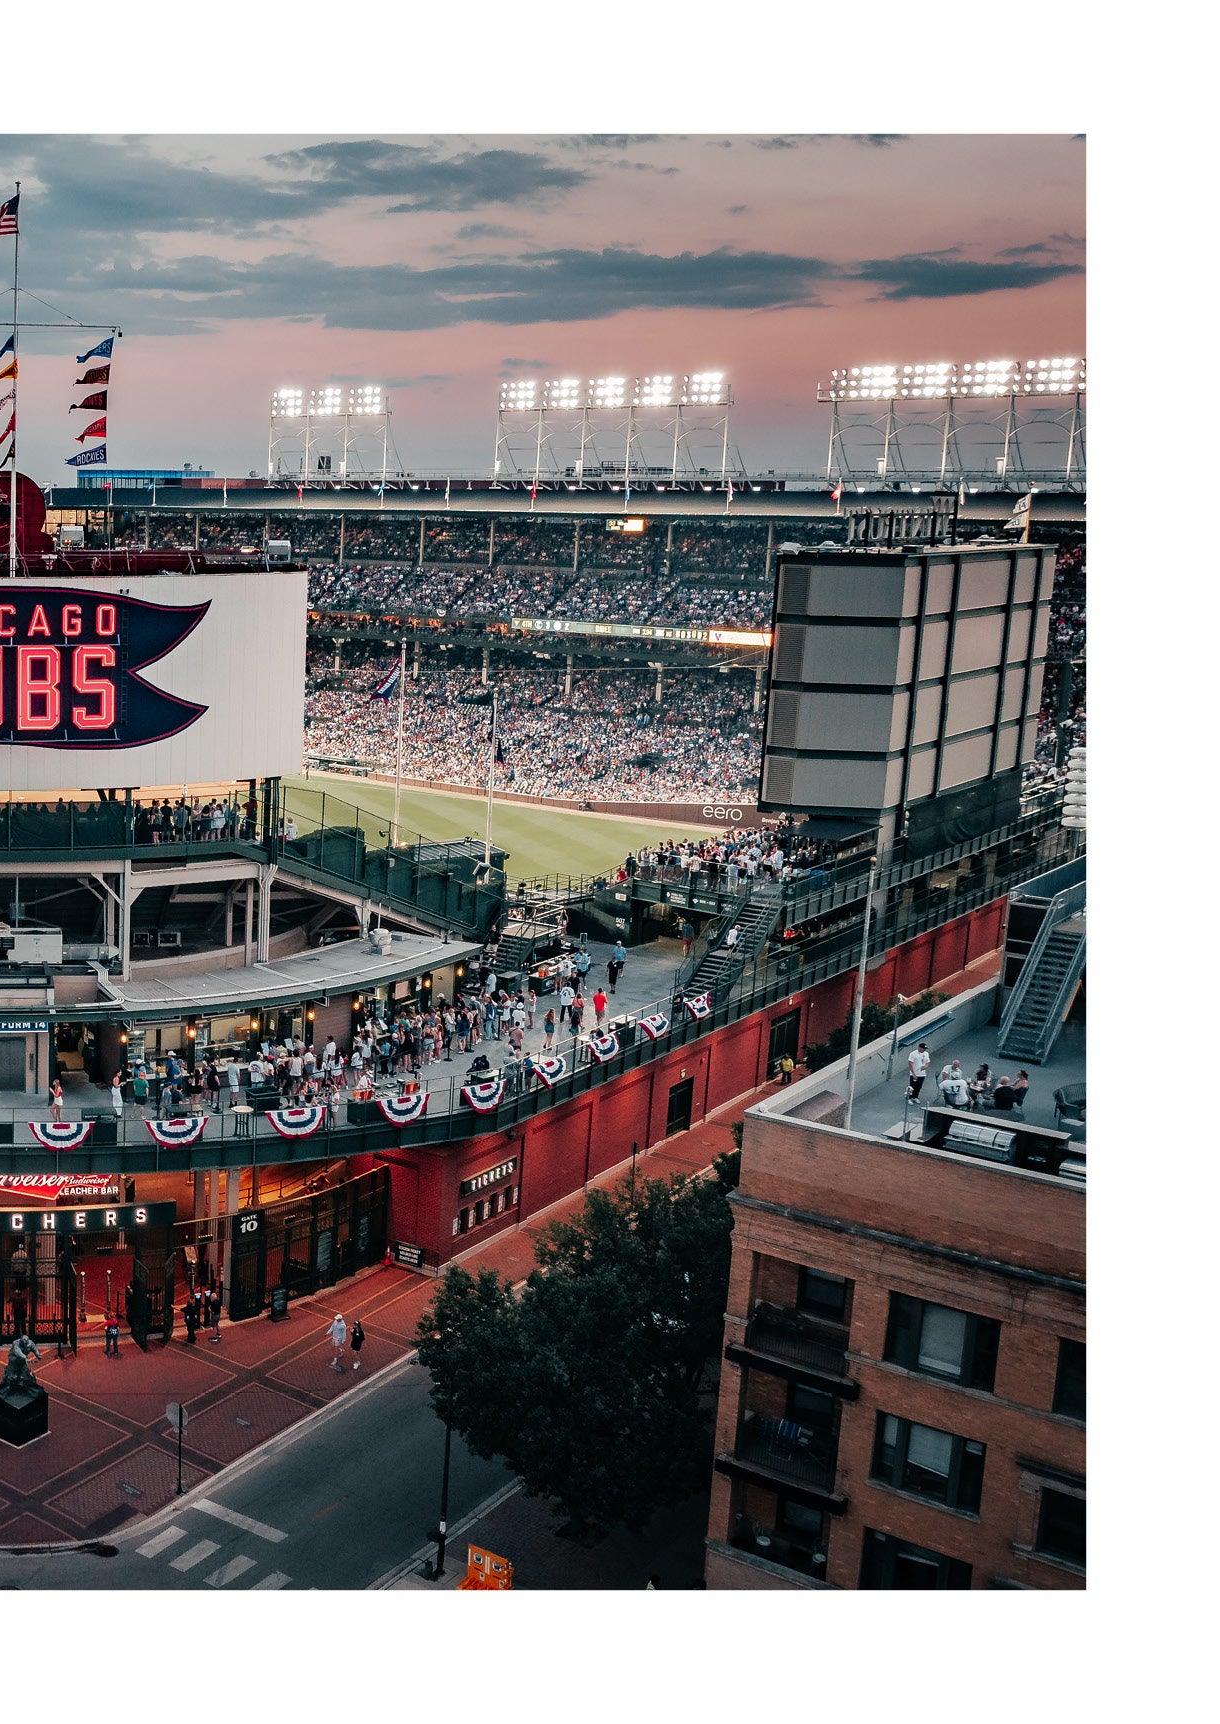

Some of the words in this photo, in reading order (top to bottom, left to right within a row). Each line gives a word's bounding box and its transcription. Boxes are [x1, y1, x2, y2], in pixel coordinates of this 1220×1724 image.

[77, 448, 105, 465] ROCKIES
[703, 806, 743, 821] eero
[470, 1161, 514, 1191] TICKETS
[59, 1187, 99, 1196] LEACHER
[100, 1186, 119, 1195] BAR
[240, 1213, 258, 1222] GATE
[239, 1220, 258, 1234] 10
